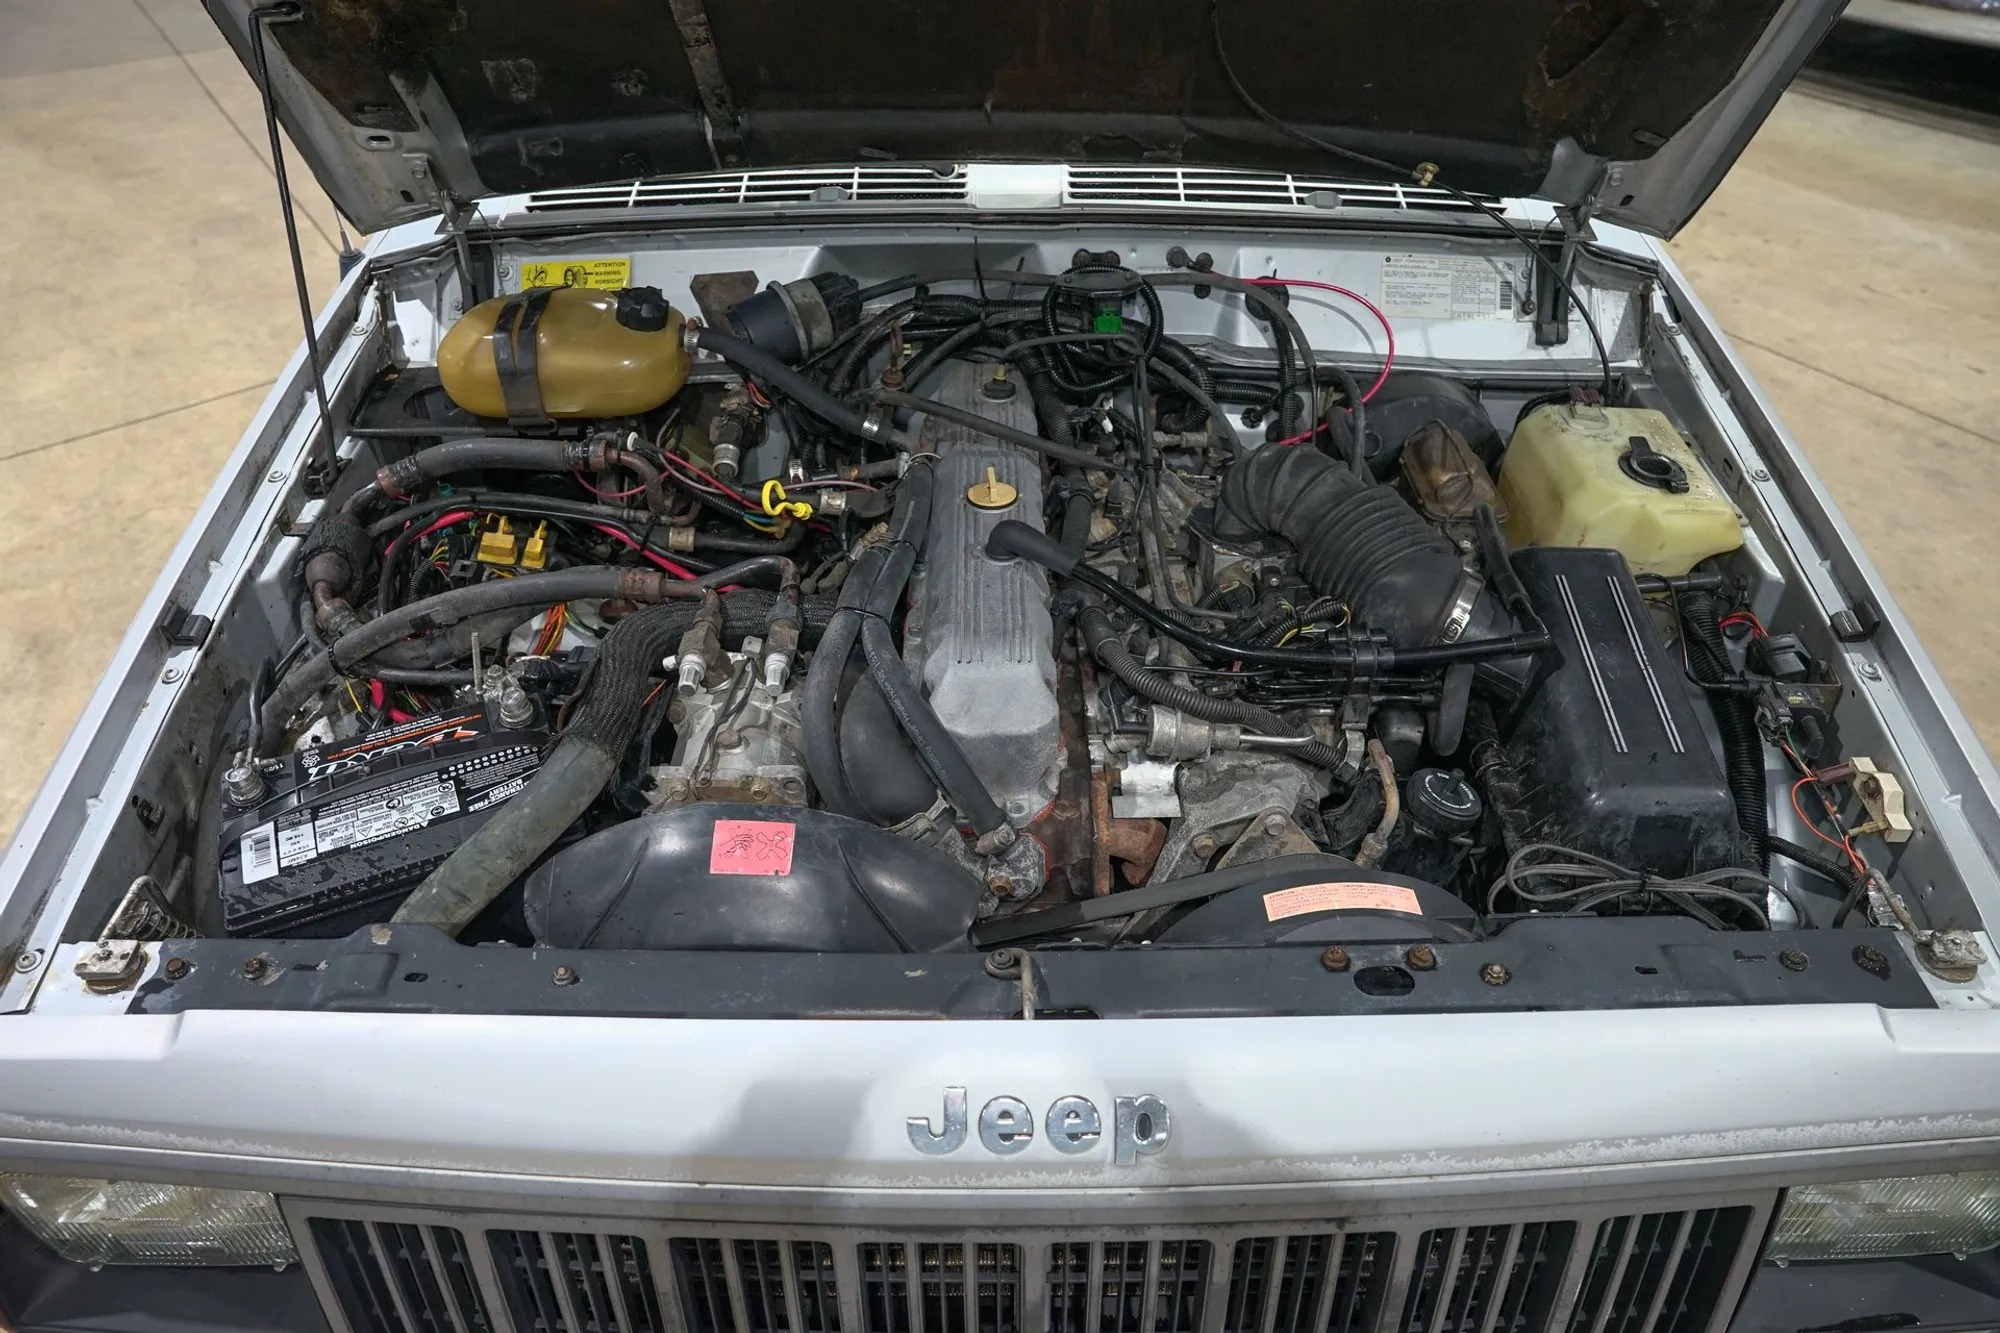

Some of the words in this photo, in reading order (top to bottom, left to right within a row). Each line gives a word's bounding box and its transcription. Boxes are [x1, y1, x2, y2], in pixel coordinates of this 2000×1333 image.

[468, 781, 530, 813] TENANCE-FREE
[488, 778, 523, 798] BATTERY
[906, 1085, 1171, 1165] Jeep
